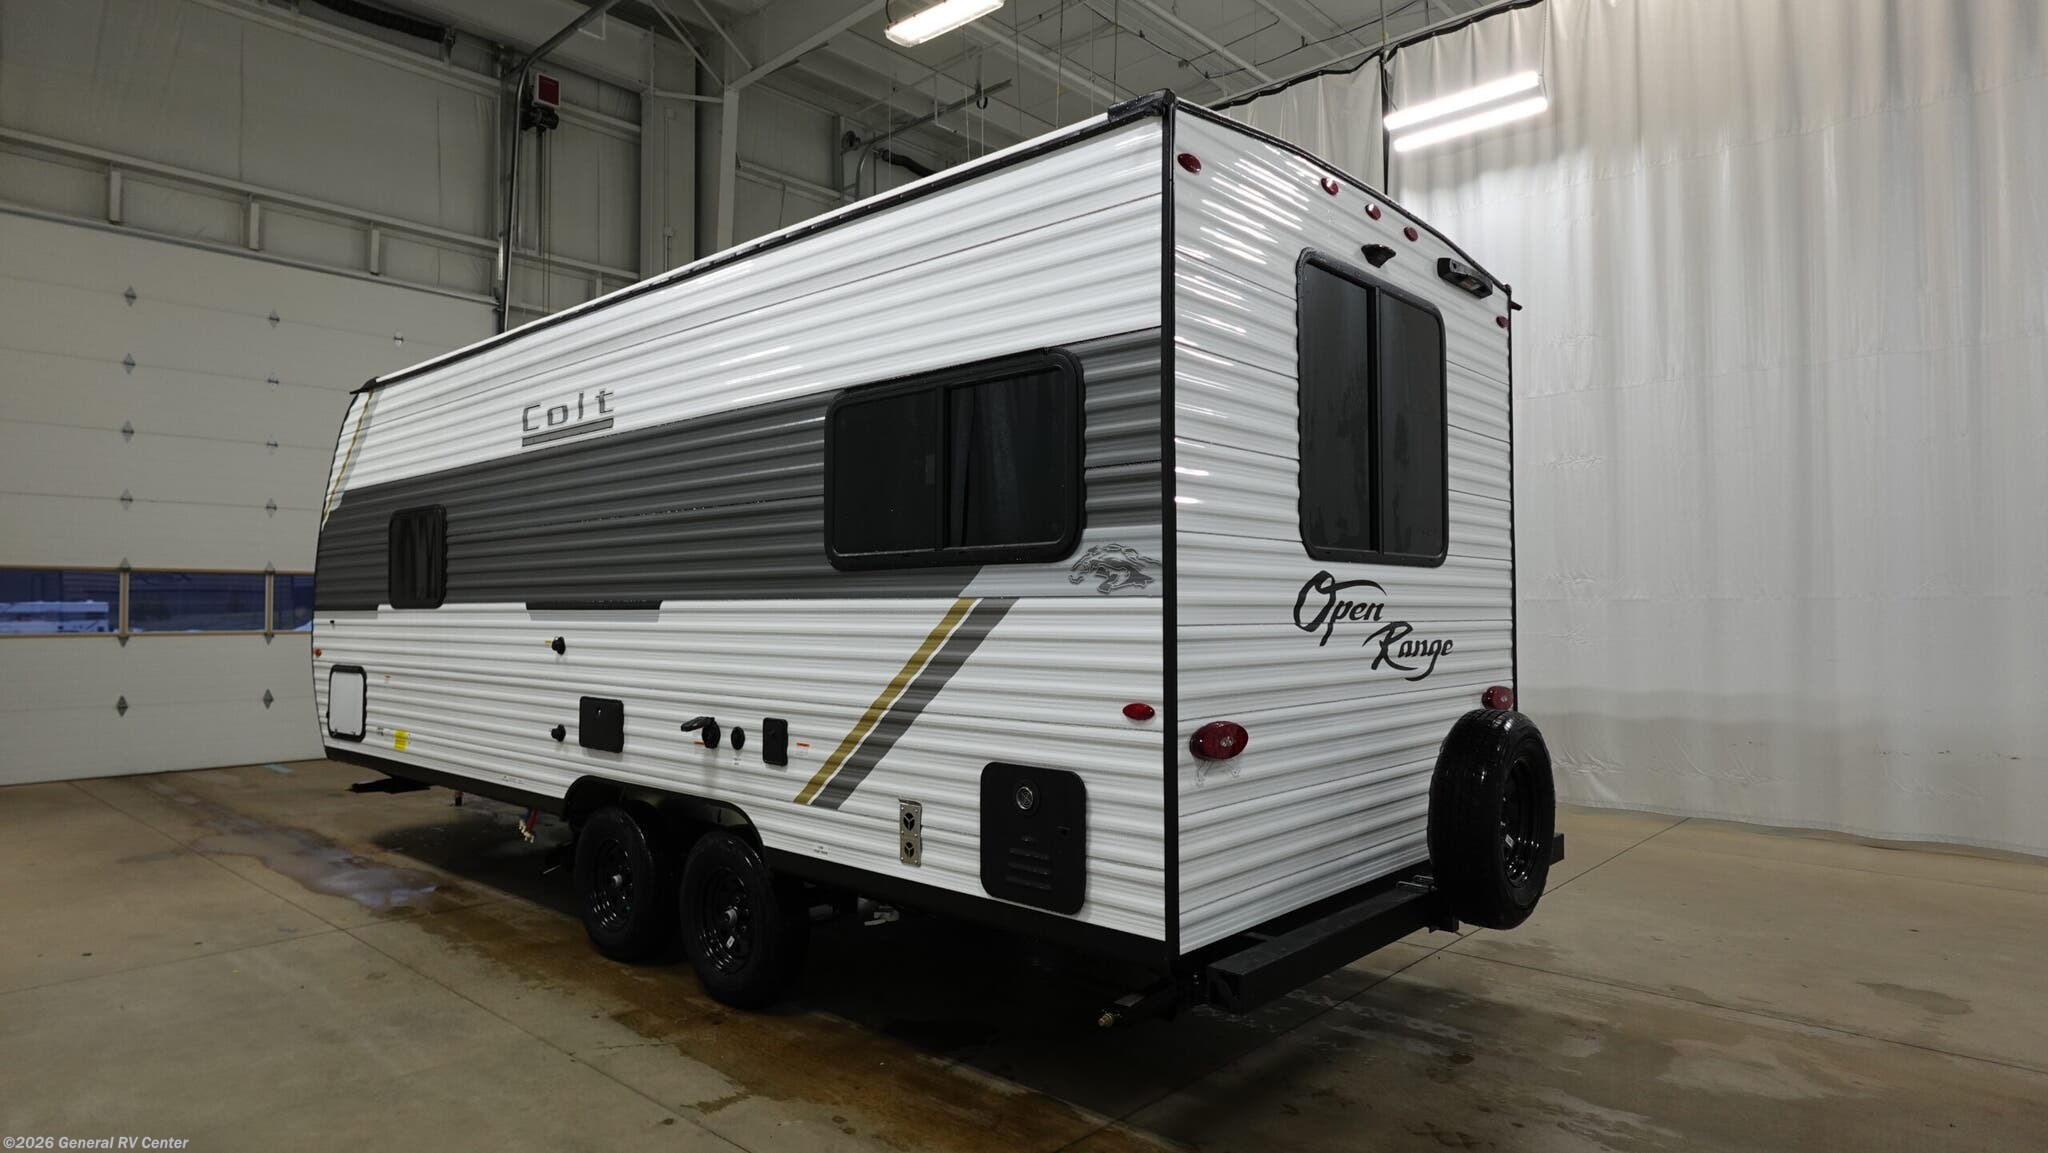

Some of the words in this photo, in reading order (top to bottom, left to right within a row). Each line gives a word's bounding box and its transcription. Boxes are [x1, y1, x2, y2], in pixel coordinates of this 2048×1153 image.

[522, 390, 614, 432] Colt
[1293, 569, 1387, 647] Open
[1361, 620, 1453, 682] Range
